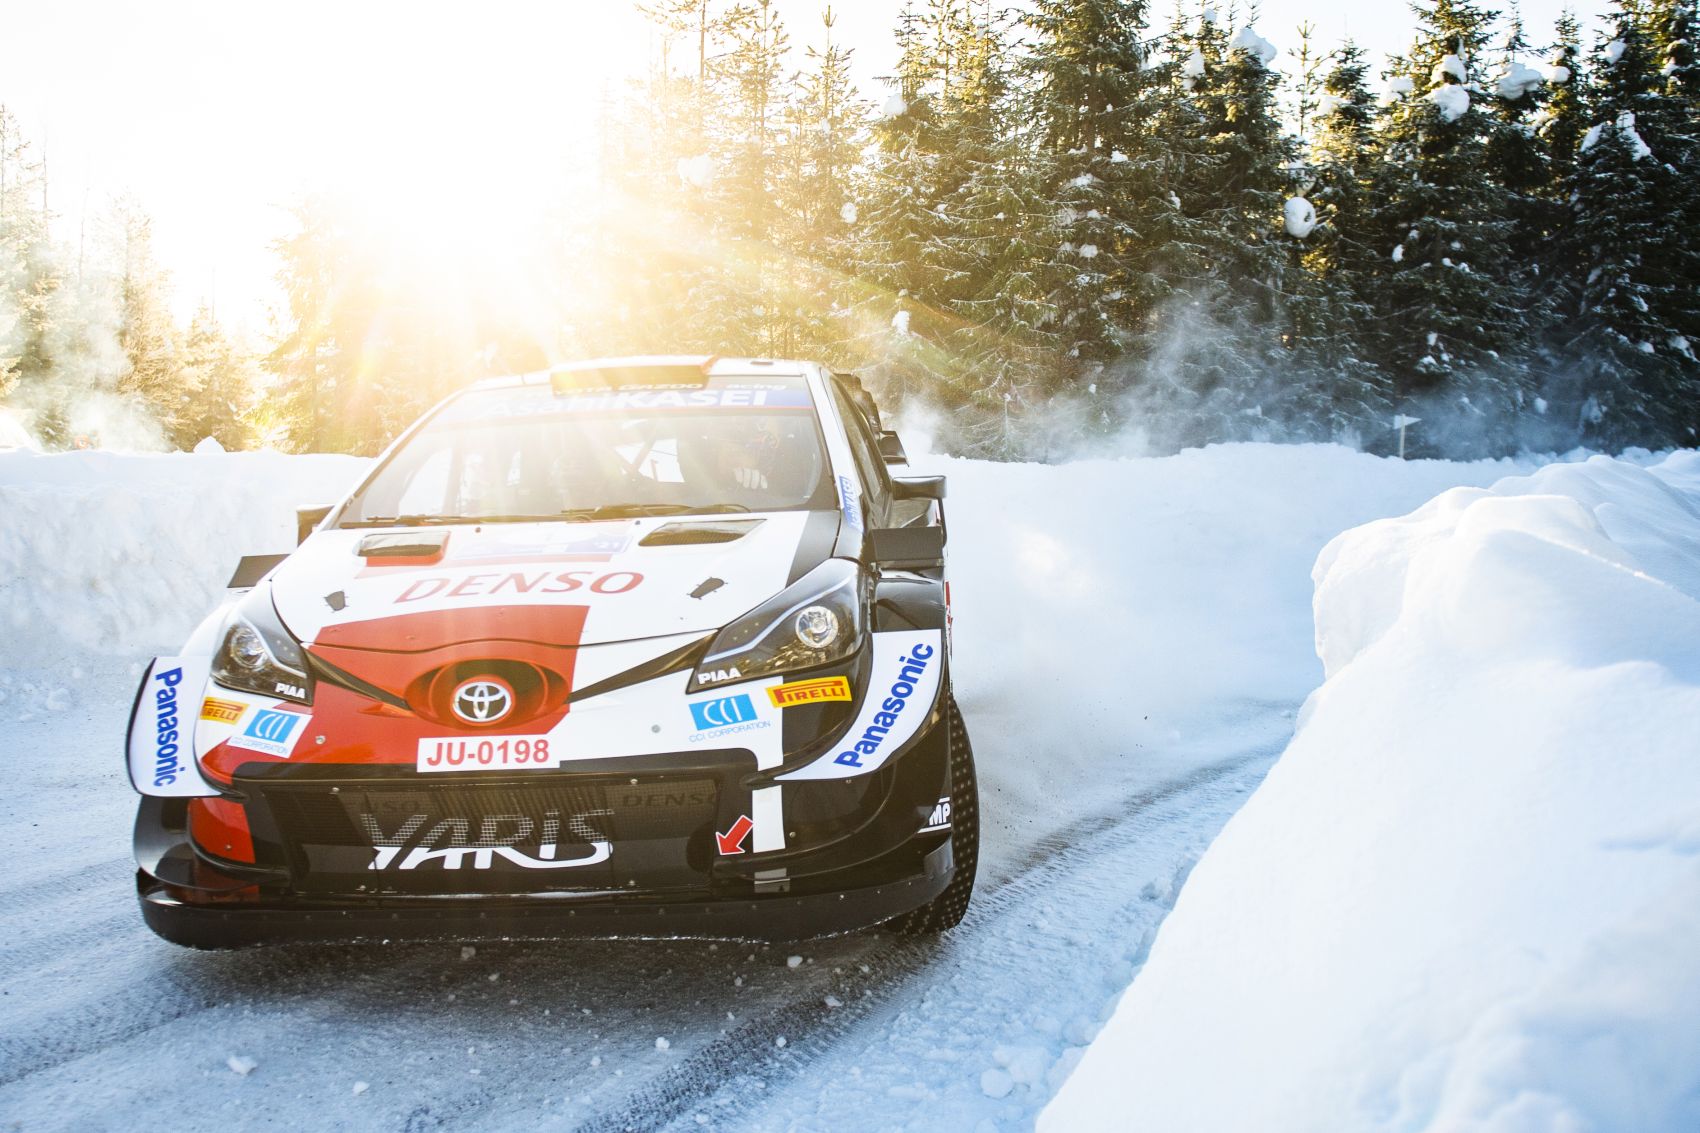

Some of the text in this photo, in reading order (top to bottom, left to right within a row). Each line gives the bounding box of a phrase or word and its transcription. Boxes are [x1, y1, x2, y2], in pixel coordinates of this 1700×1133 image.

[394, 571, 645, 604] DENSO
[698, 667, 742, 685] PIAA
[274, 682, 306, 699] PIAA
[773, 680, 846, 704] PIRELLI
[833, 643, 934, 769] Panasonic
[153, 667, 184, 788] Panasonic
[688, 720, 771, 743] CCI CORPORATION
[426, 739, 550, 767] JU-0198
